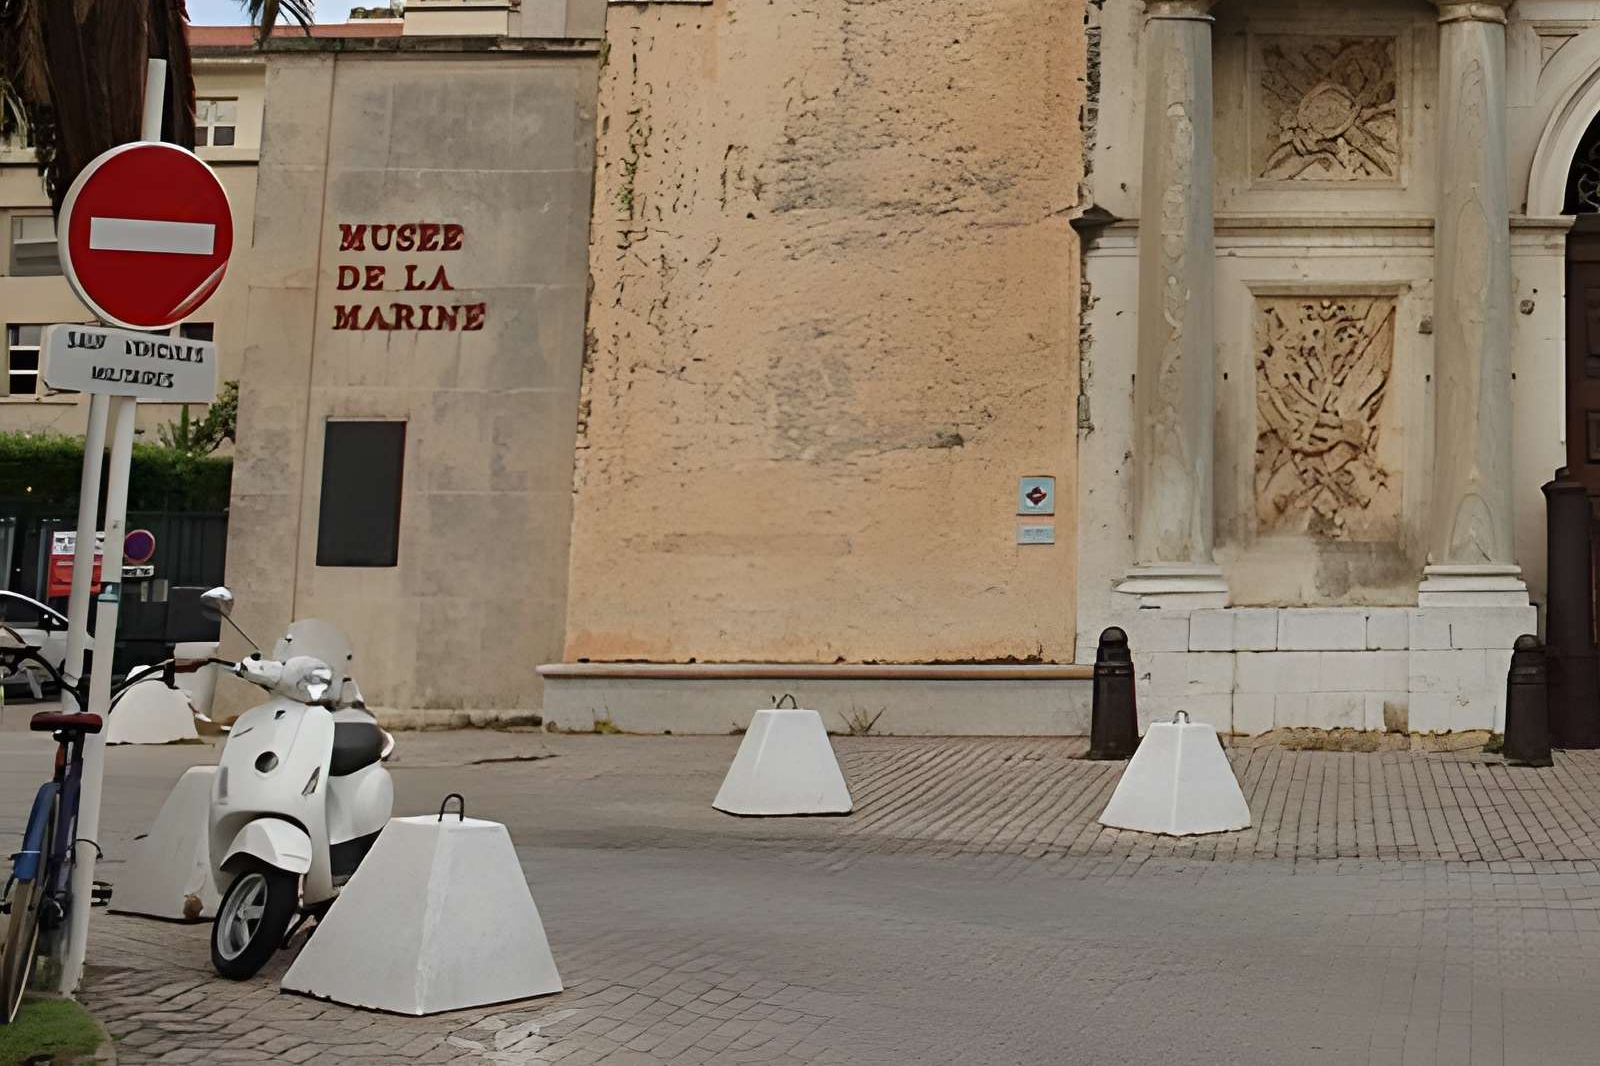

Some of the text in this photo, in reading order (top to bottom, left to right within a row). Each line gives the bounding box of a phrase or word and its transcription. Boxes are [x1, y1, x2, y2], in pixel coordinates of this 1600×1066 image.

[337, 264, 454, 290] DE LA
[332, 302, 486, 331] MARINE
